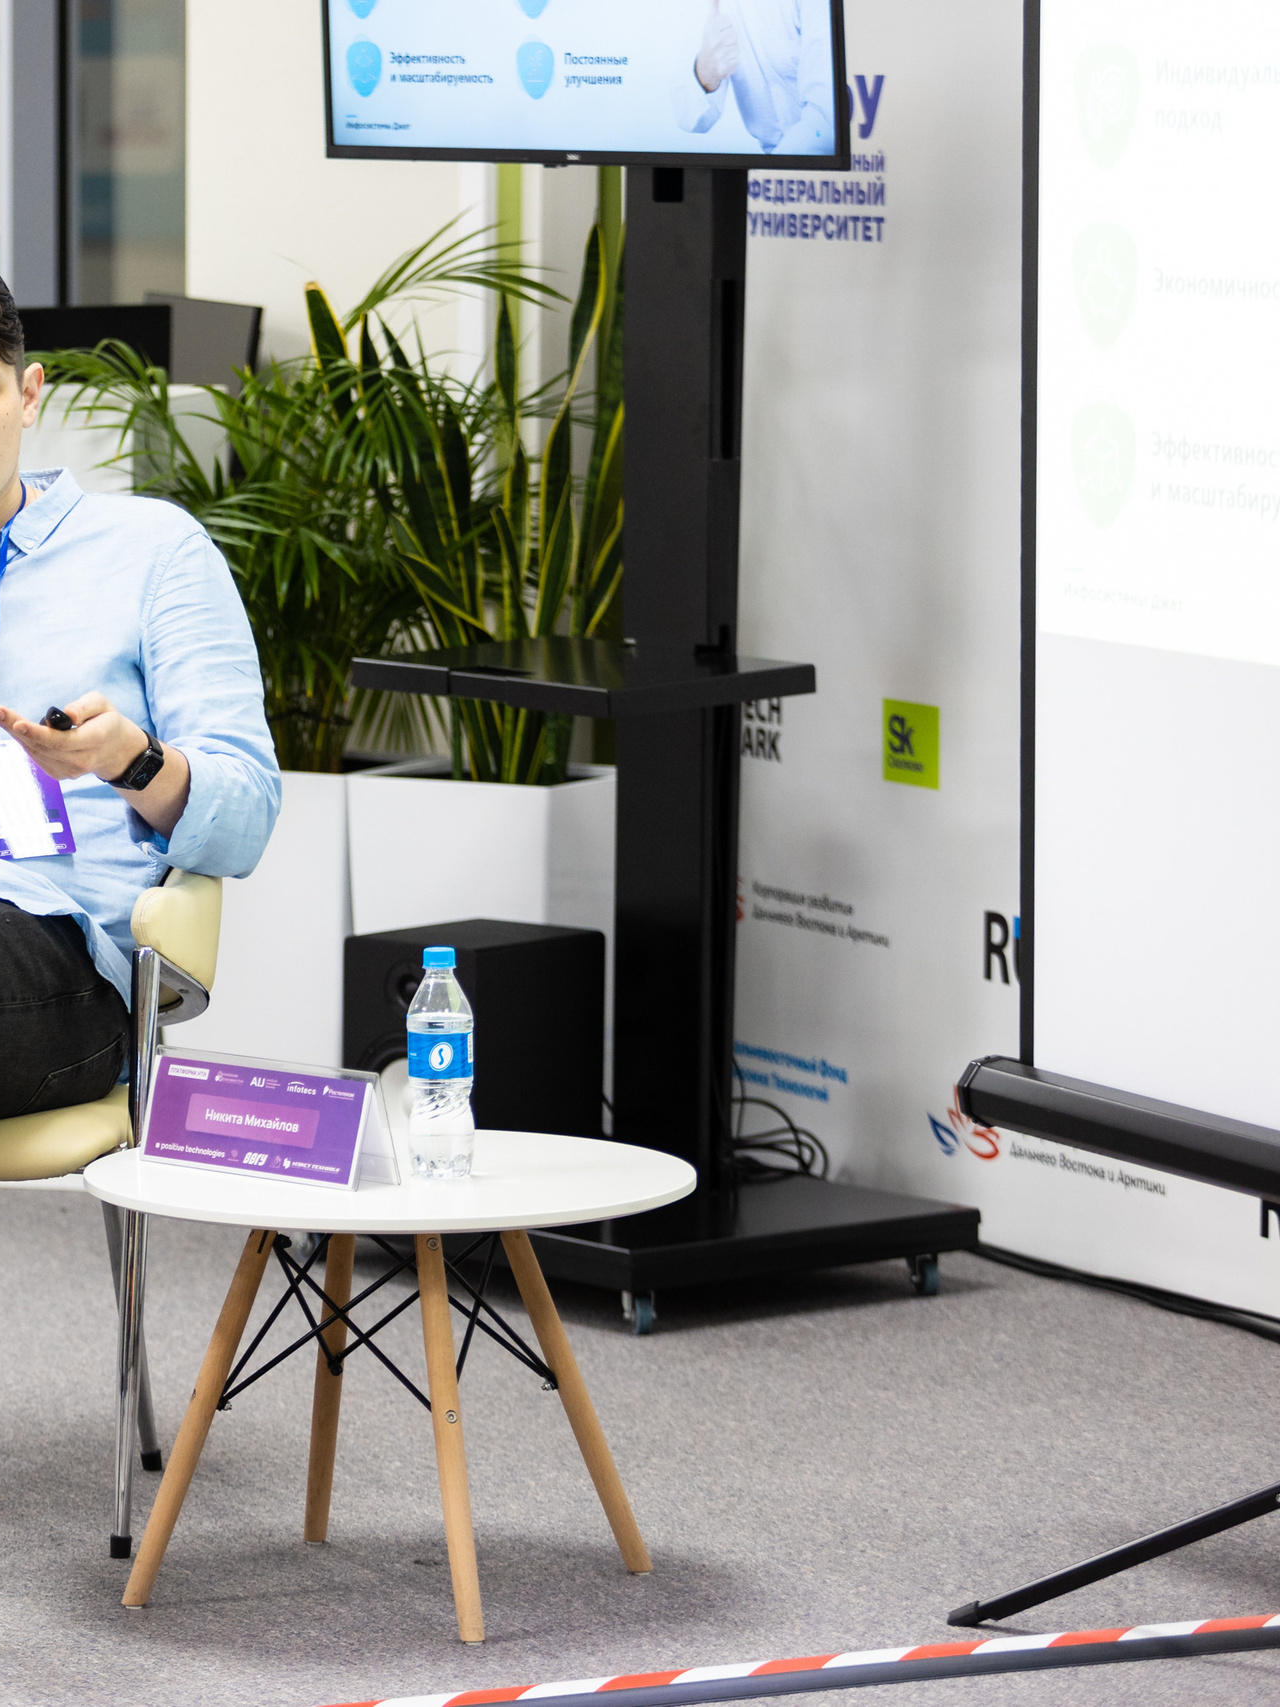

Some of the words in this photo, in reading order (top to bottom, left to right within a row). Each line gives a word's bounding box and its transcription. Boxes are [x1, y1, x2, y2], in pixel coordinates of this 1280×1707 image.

[389, 51, 466, 66] Эффективность
[563, 52, 629, 66] Постоянные
[389, 73, 397, 83] и
[399, 71, 494, 87] масштабируемость
[563, 74, 623, 89] улучшения
[1154, 108, 1223, 136] подход
[747, 175, 885, 207] ФЕДЕРАЛЬНЫЙ
[747, 211, 885, 243] УНИВЕРСИТЕТ
[1151, 430, 1280, 468] Эффективнос
[742, 696, 782, 726] ECH
[740, 726, 782, 763] ARK
[286, 1082, 317, 1096] infotecs
[205, 1108, 244, 1125] Никита
[244, 1113, 299, 1133] Михайлов
[160, 1142, 185, 1152] positive
[185, 1145, 226, 1159] technologies
[1009, 1141, 1058, 1167] Дальнего
[1058, 1152, 1106, 1181] Востока
[1115, 1168, 1167, 1196] Арктики
